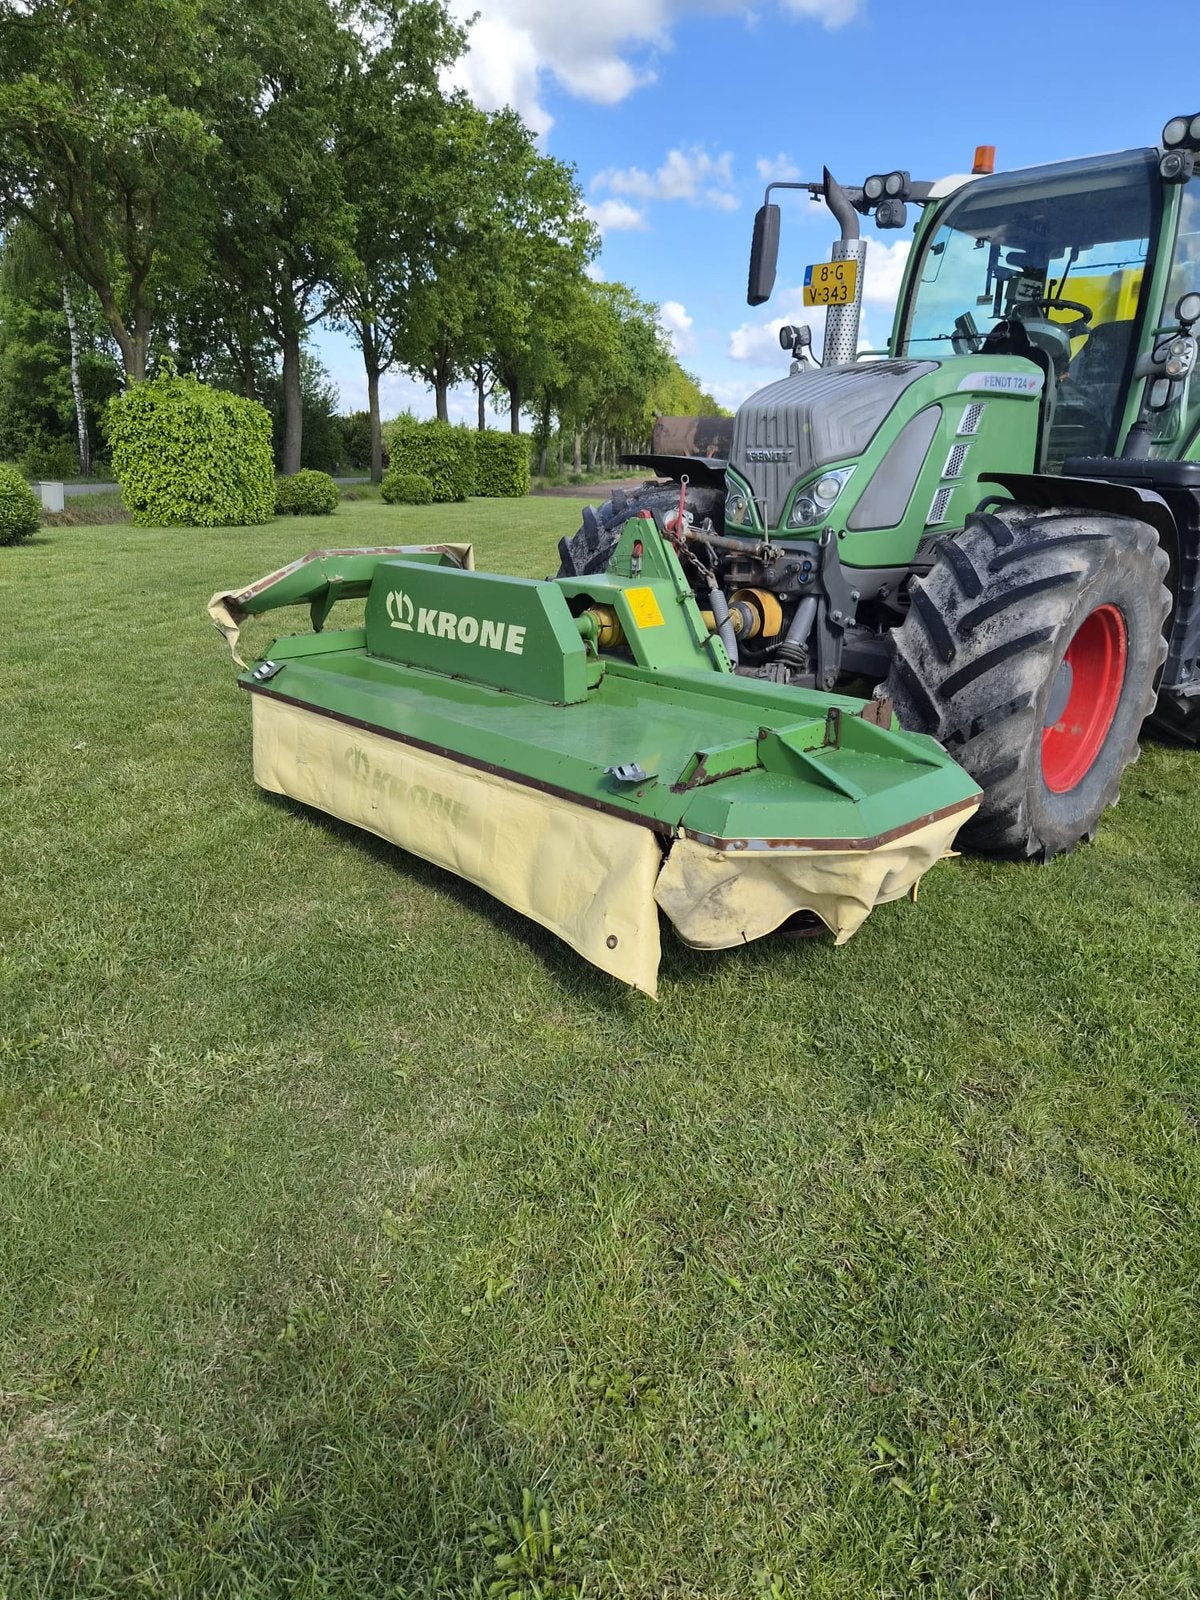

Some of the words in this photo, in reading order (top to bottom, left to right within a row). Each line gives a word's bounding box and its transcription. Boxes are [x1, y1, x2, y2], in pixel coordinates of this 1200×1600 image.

[820, 264, 844, 282] 8-G
[809, 285, 848, 304] V-343
[984, 375, 1012, 388] FENDT
[1013, 377, 1027, 389] 724
[417, 607, 527, 655] KRONE
[372, 768, 470, 825] KRONE
